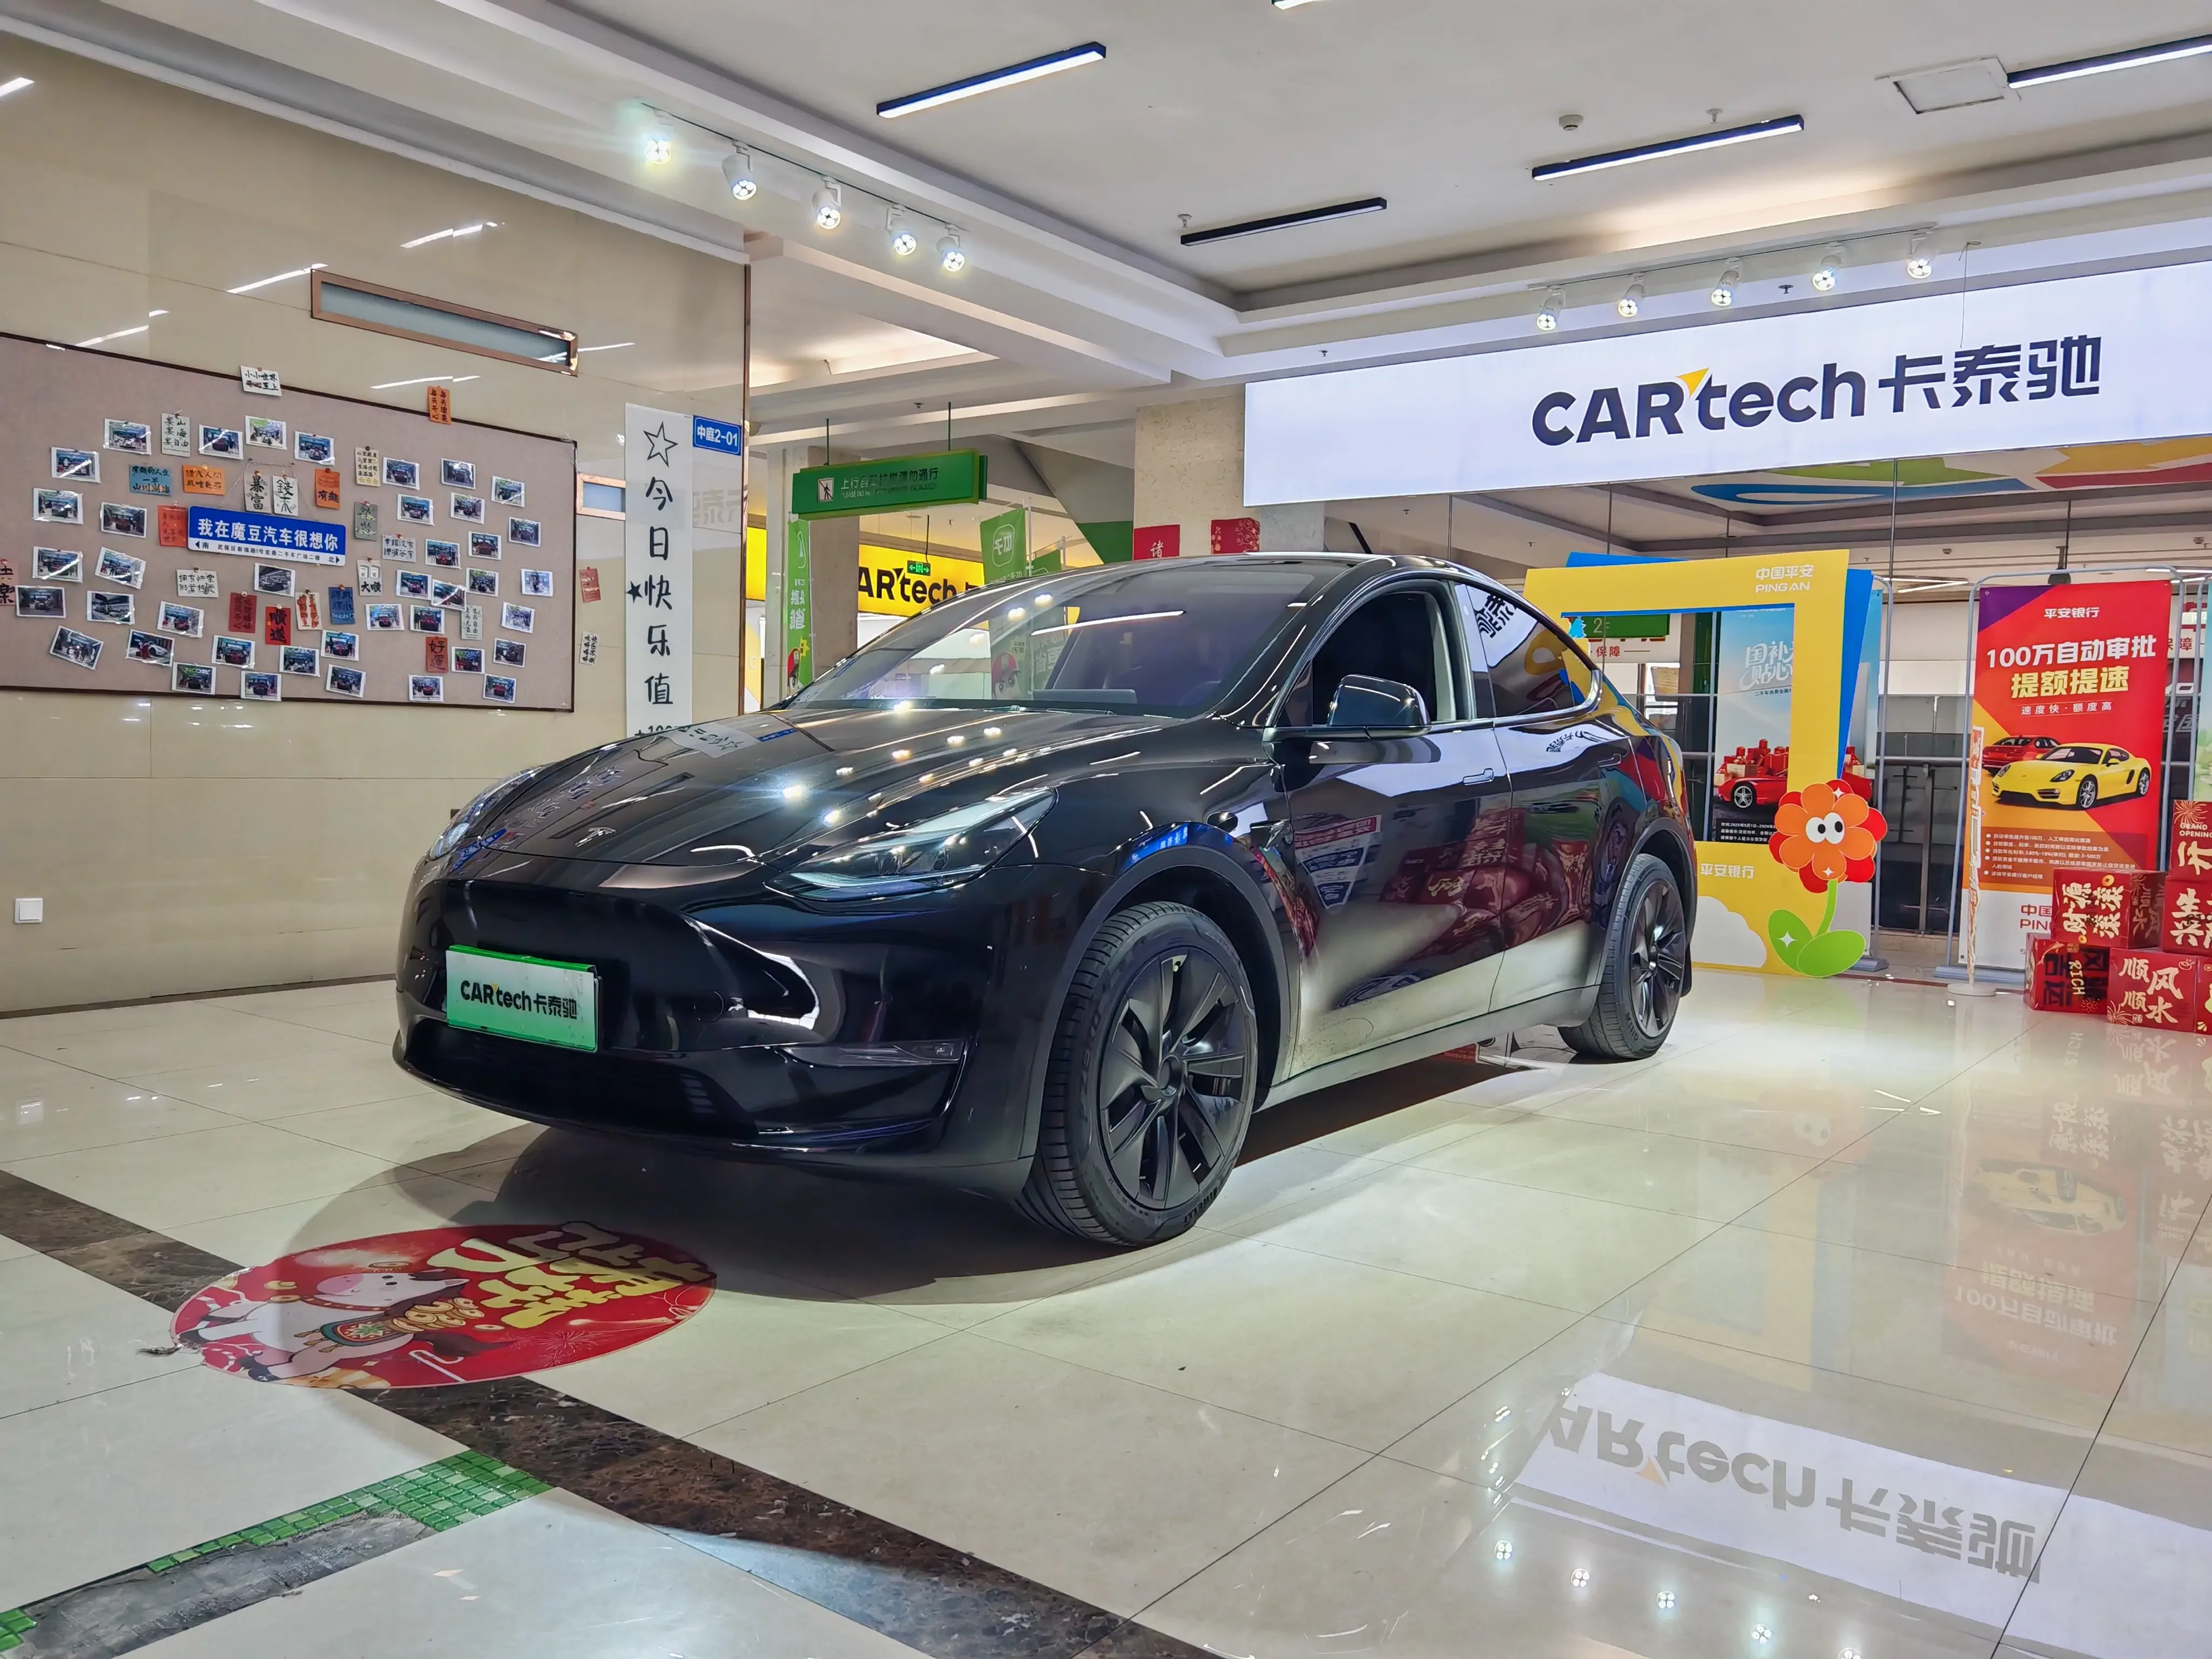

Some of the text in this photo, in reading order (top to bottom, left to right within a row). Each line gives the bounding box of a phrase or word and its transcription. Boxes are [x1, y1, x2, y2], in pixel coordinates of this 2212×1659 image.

[1532, 334, 2102, 446] CARtech 卡泰驰
[198, 518, 339, 551] 我在魔豆汽车很想你
[202, 541, 209, 549] 南
[1756, 564, 1814, 581] 中国平安
[644, 476, 673, 705] 今日快乐值
[2044, 606, 2100, 619] 平安银行
[1596, 646, 1621, 657] 保障
[1986, 635, 2157, 669] 100万自动审批
[2010, 665, 2129, 699] 提额提速
[1700, 863, 1755, 879] 平安银行
[2068, 960, 2086, 995] RICH
[460, 979, 578, 1021] CARtech 卡泰驰
